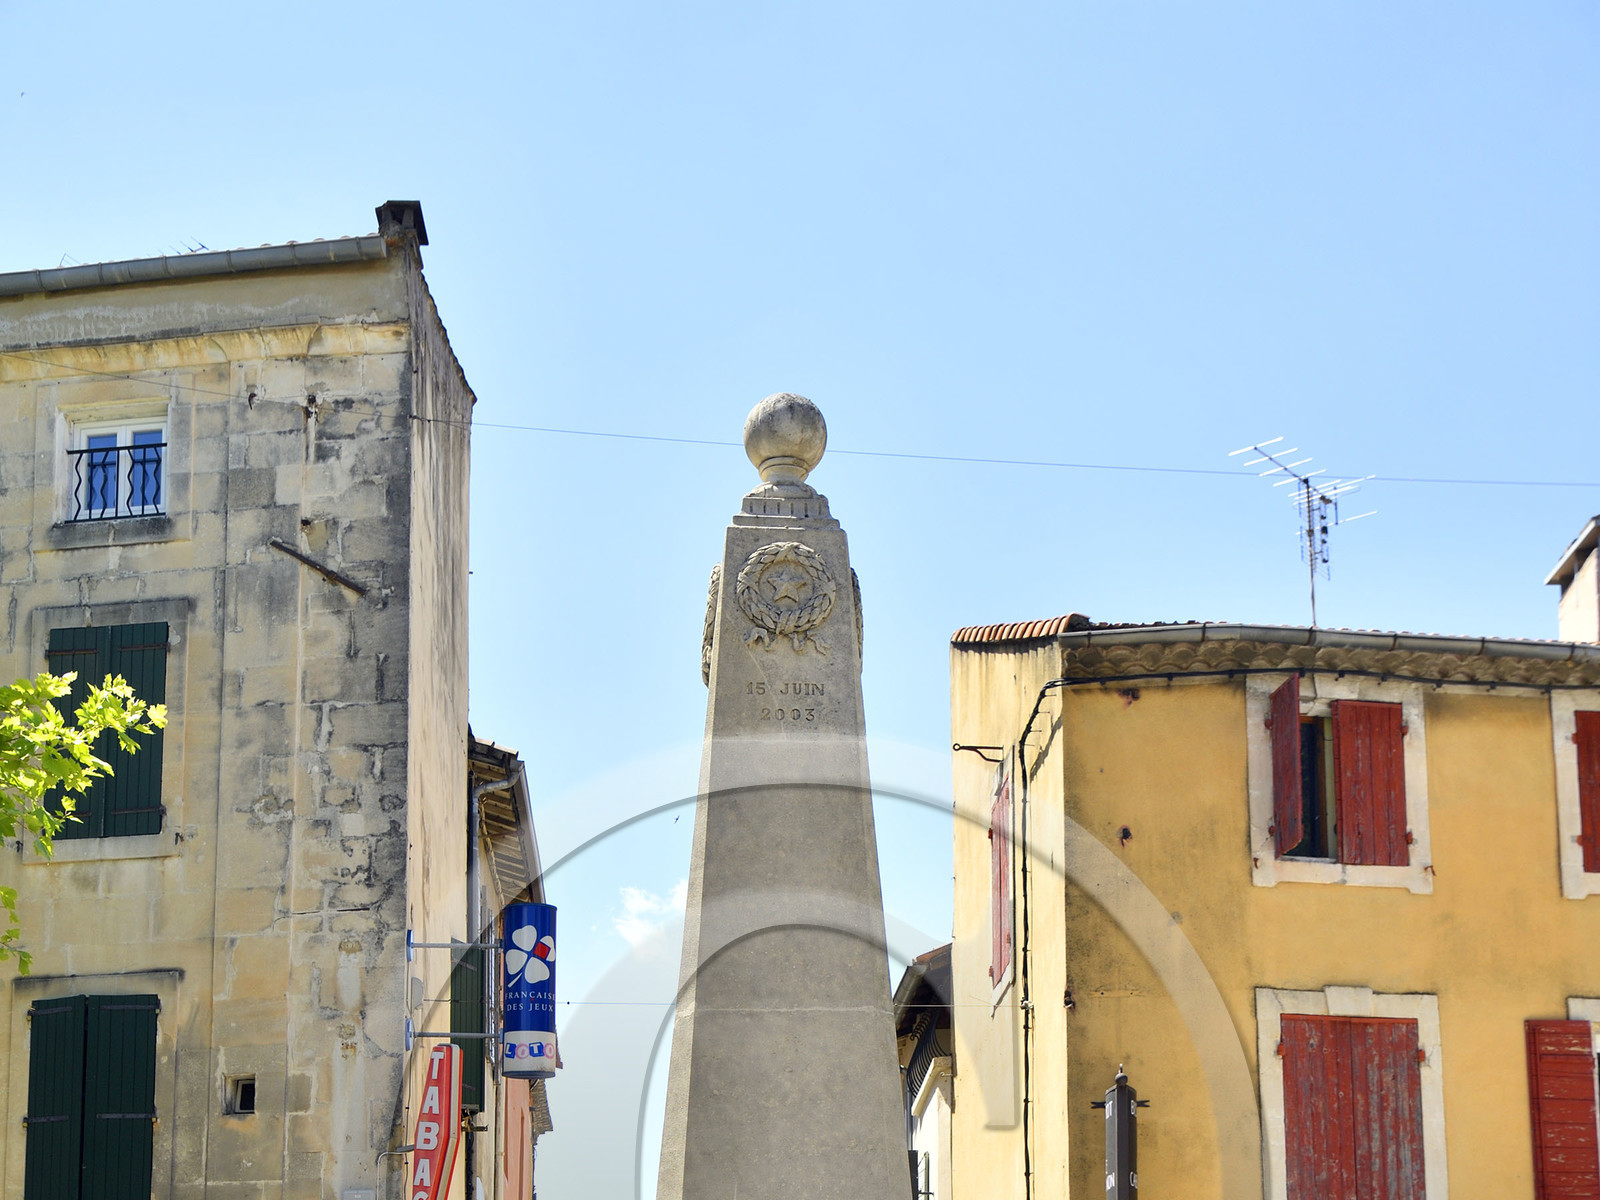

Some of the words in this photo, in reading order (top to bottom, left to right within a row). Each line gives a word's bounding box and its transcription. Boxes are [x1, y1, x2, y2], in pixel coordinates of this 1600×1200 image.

[746, 682, 766, 695] 15
[780, 683, 825, 696] JUIN
[760, 708, 815, 721] 2003
[507, 1003, 523, 1011] DES
[529, 1003, 553, 1012] JEUX
[505, 1042, 555, 1059] LOTO
